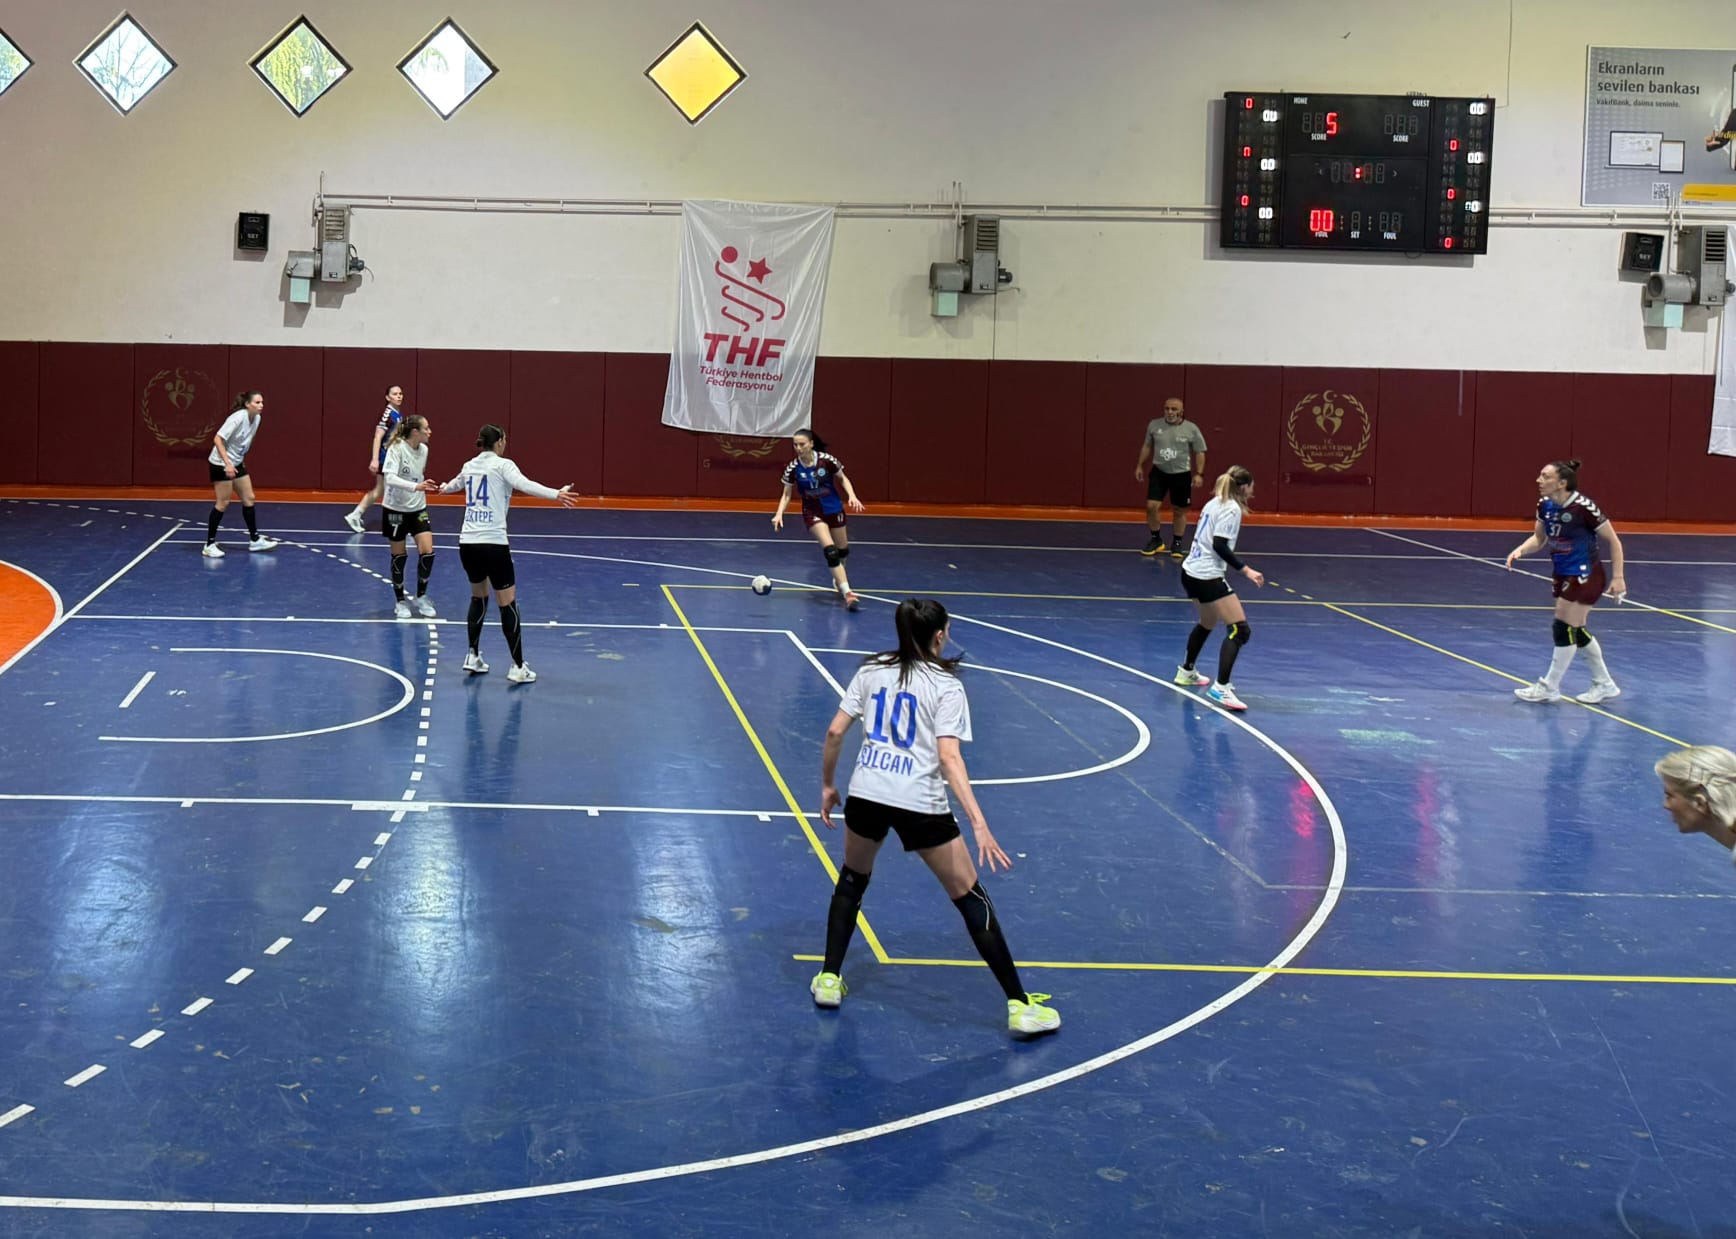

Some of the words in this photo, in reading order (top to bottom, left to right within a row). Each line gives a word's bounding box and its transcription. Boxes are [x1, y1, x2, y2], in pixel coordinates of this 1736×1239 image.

[1598, 61, 1665, 75] Ekranların
[1597, 80, 1644, 92] sevilen
[1649, 80, 1700, 95] bankası
[1245, 98, 1253, 109] 0
[1326, 112, 1338, 134] 5
[1450, 140, 1457, 151] 0
[1261, 158, 1275, 170] 00
[1241, 195, 1249, 206] 0
[1447, 189, 1455, 199] 0
[1259, 207, 1273, 219] 00
[1310, 210, 1334, 232] 00
[1444, 238, 1452, 248] 0
[704, 332, 786, 366] THF
[700, 366, 738, 380] Türkiye
[740, 371, 783, 382] Hentbol
[706, 377, 774, 391] Federasyonu
[466, 474, 489, 507] 14
[391, 524, 399, 536] 7
[1550, 524, 1562, 536] 37
[867, 686, 917, 749] 10
